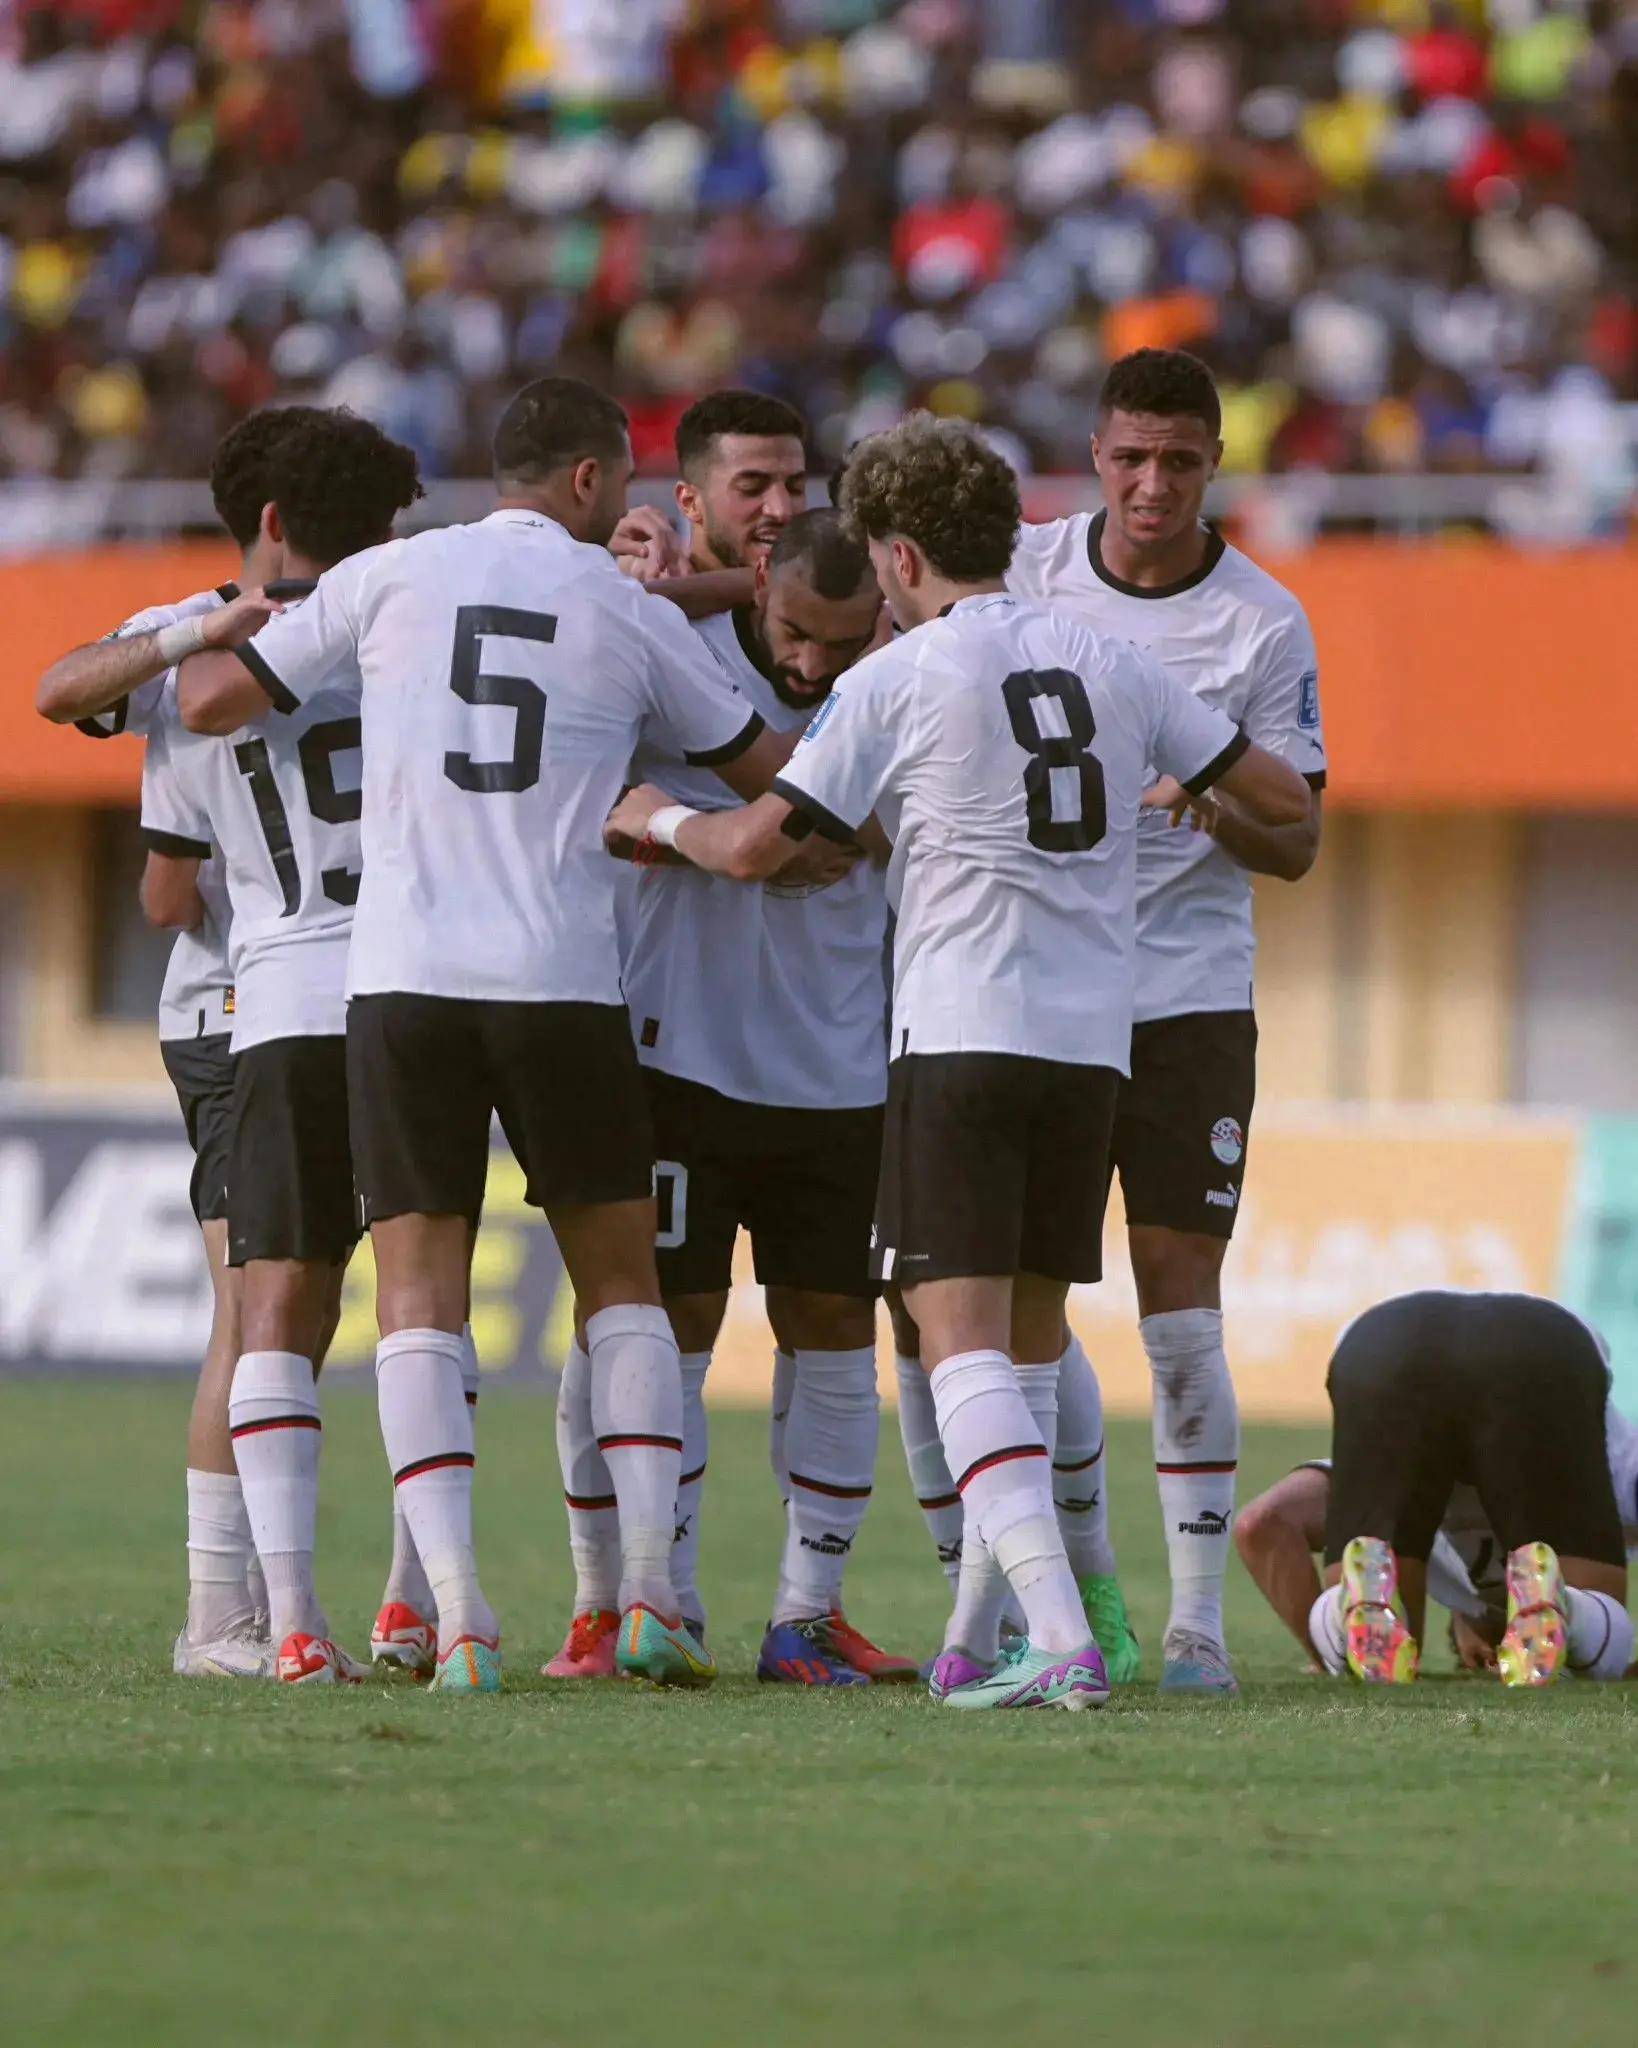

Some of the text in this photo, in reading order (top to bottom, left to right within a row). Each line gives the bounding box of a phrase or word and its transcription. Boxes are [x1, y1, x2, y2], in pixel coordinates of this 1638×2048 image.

[444, 604, 559, 793] 5
[1001, 667, 1107, 853] 8
[234, 717, 363, 918] 19
